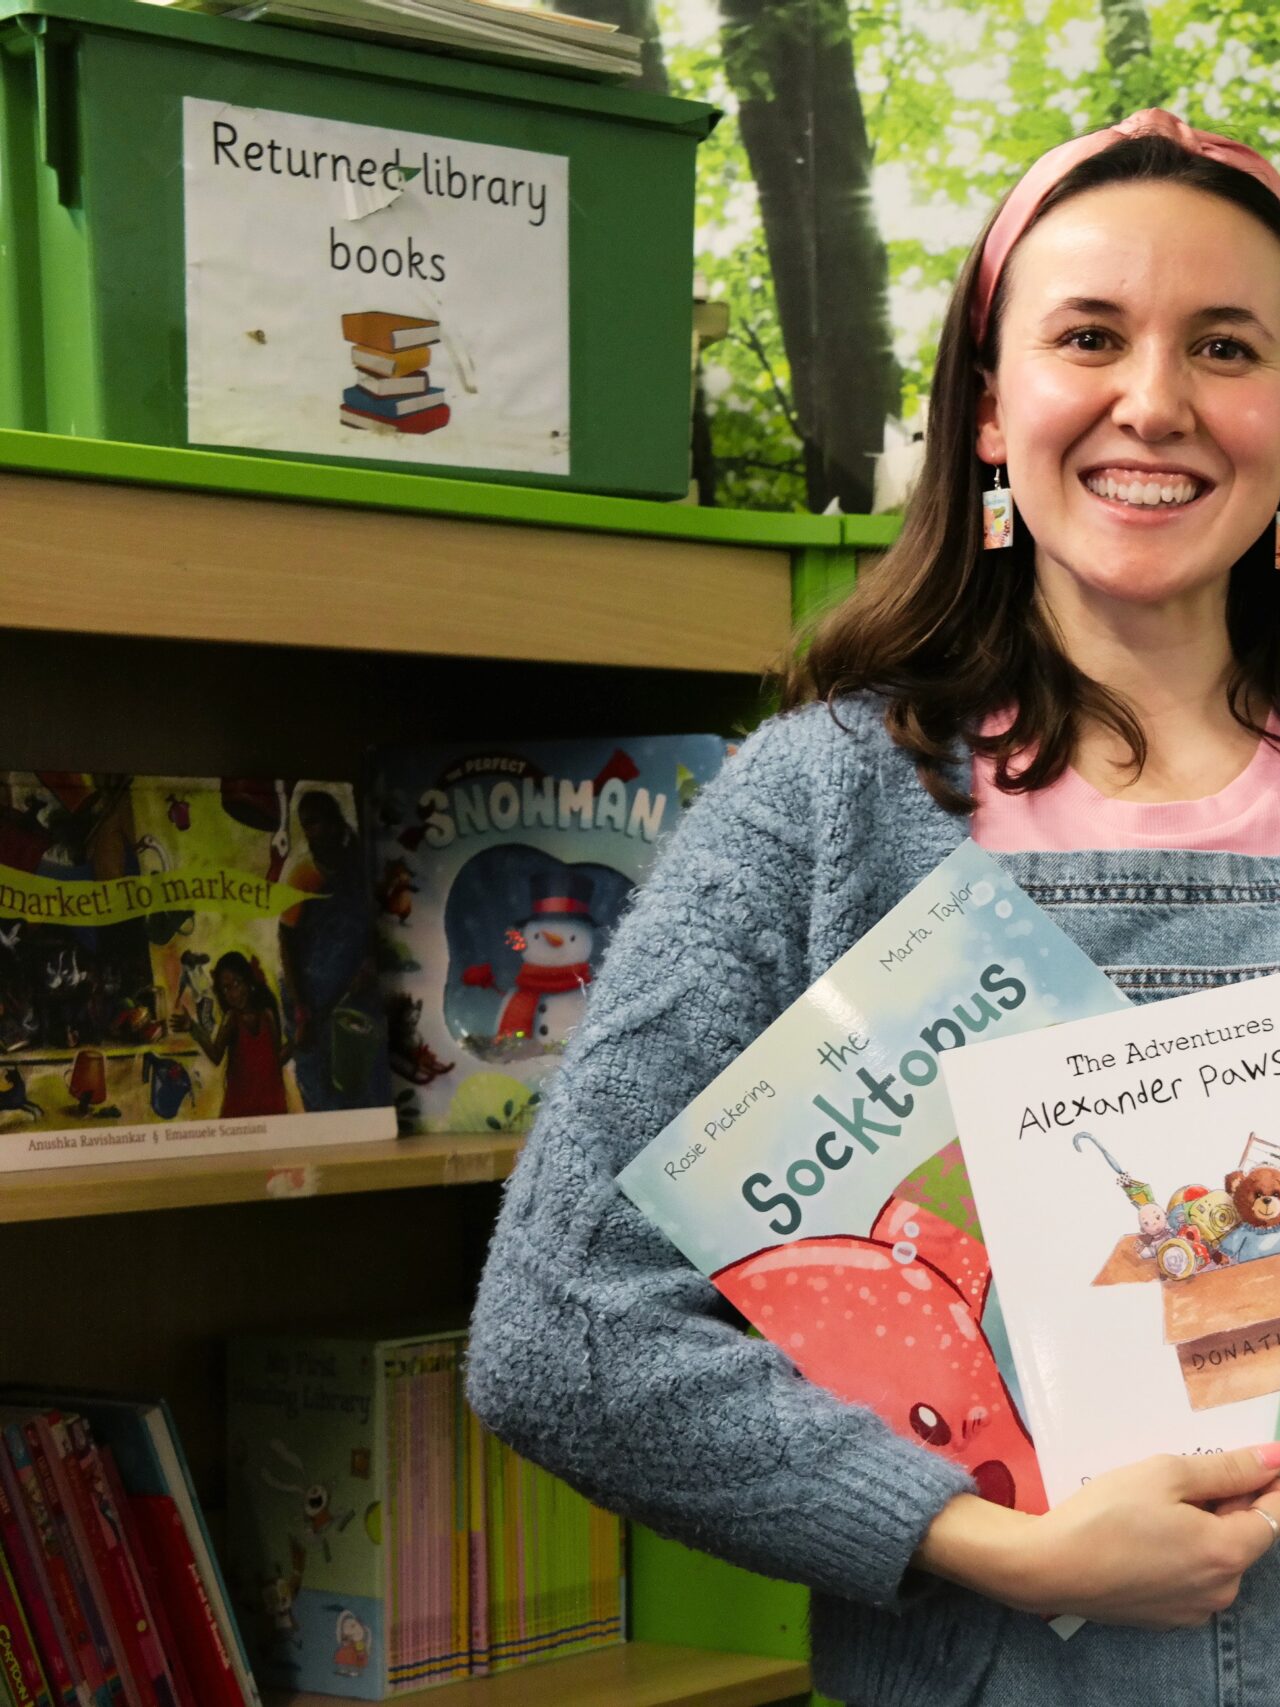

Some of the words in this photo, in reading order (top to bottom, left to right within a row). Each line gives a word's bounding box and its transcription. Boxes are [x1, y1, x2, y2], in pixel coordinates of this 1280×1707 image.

[212, 121, 401, 192] Returned
[423, 152, 547, 227] library
[330, 226, 447, 282] books
[465, 757, 527, 774] PERFECT
[417, 776, 668, 849] SNOWMAN
[0, 886, 111, 917] market!
[117, 880, 153, 911] To
[162, 871, 273, 910] market!
[878, 926, 932, 973] Marta
[927, 881, 974, 923] Taylor
[816, 1031, 870, 1073] the
[1066, 1053, 1117, 1077] The
[1124, 1016, 1274, 1065] Adventures
[662, 1142, 707, 1181] Rosie
[703, 1078, 776, 1141] Pickering
[740, 963, 1027, 1236] Socktopus
[1018, 1077, 1183, 1141] Alexander
[29, 1139, 78, 1152] Anushka
[80, 1132, 147, 1147] Ravishankar
[165, 1126, 217, 1141] Emanuele
